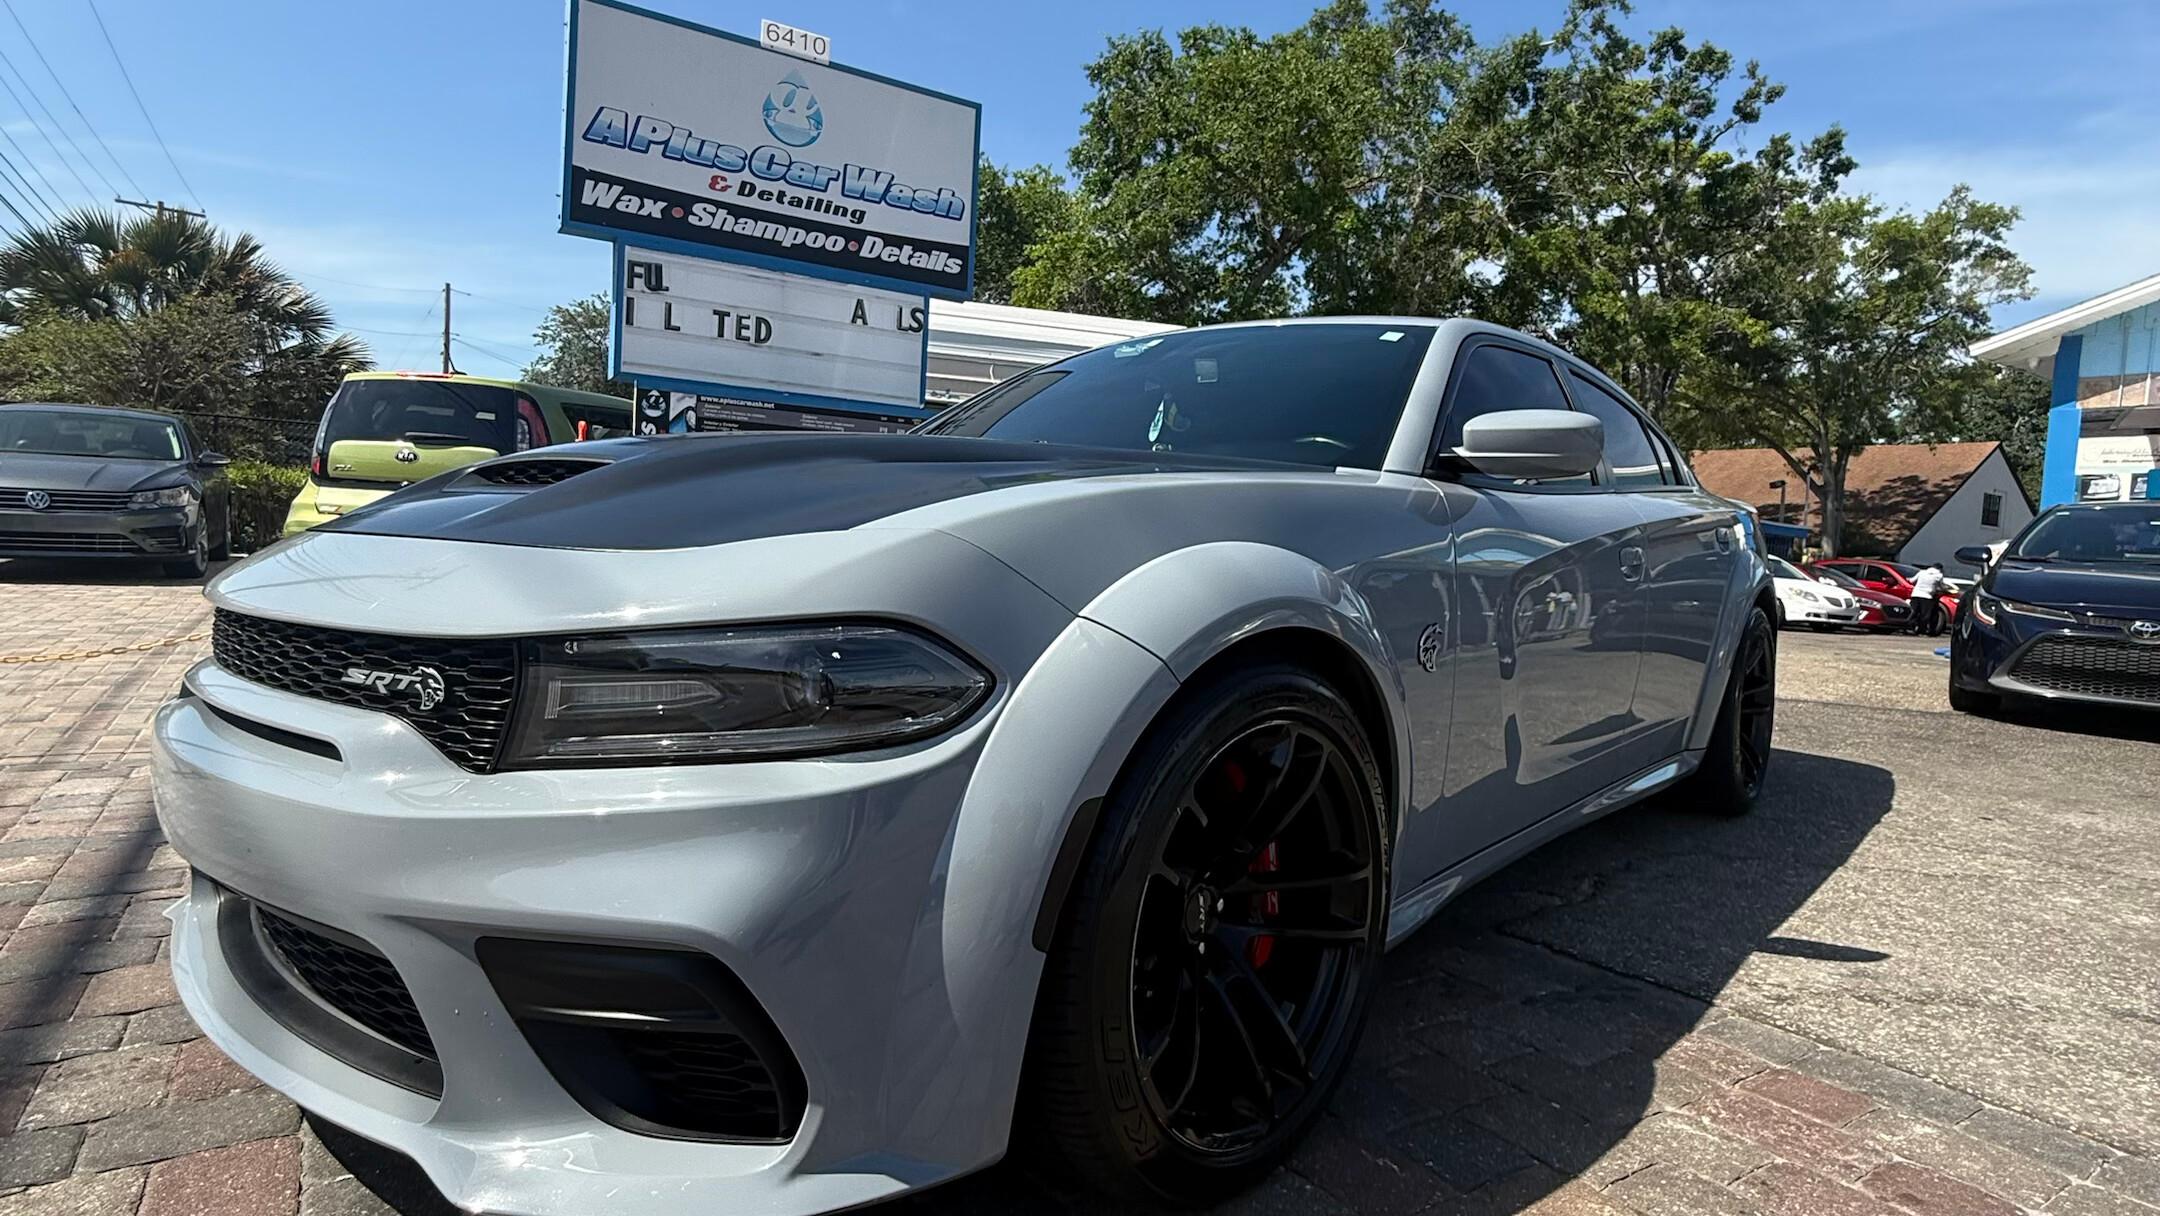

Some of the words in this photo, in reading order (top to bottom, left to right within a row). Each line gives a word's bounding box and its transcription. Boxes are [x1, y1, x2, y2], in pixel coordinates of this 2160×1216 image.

[766, 23, 826, 55] 6410
[708, 175, 733, 192] &
[737, 180, 866, 225] Detailing
[748, 144, 841, 193] Car
[841, 163, 965, 221] Wash
[581, 179, 668, 219] Wax
[688, 203, 846, 252] Shampoo
[859, 235, 963, 274] Details
[713, 309, 772, 344] TED
[341, 667, 423, 694] SRT
